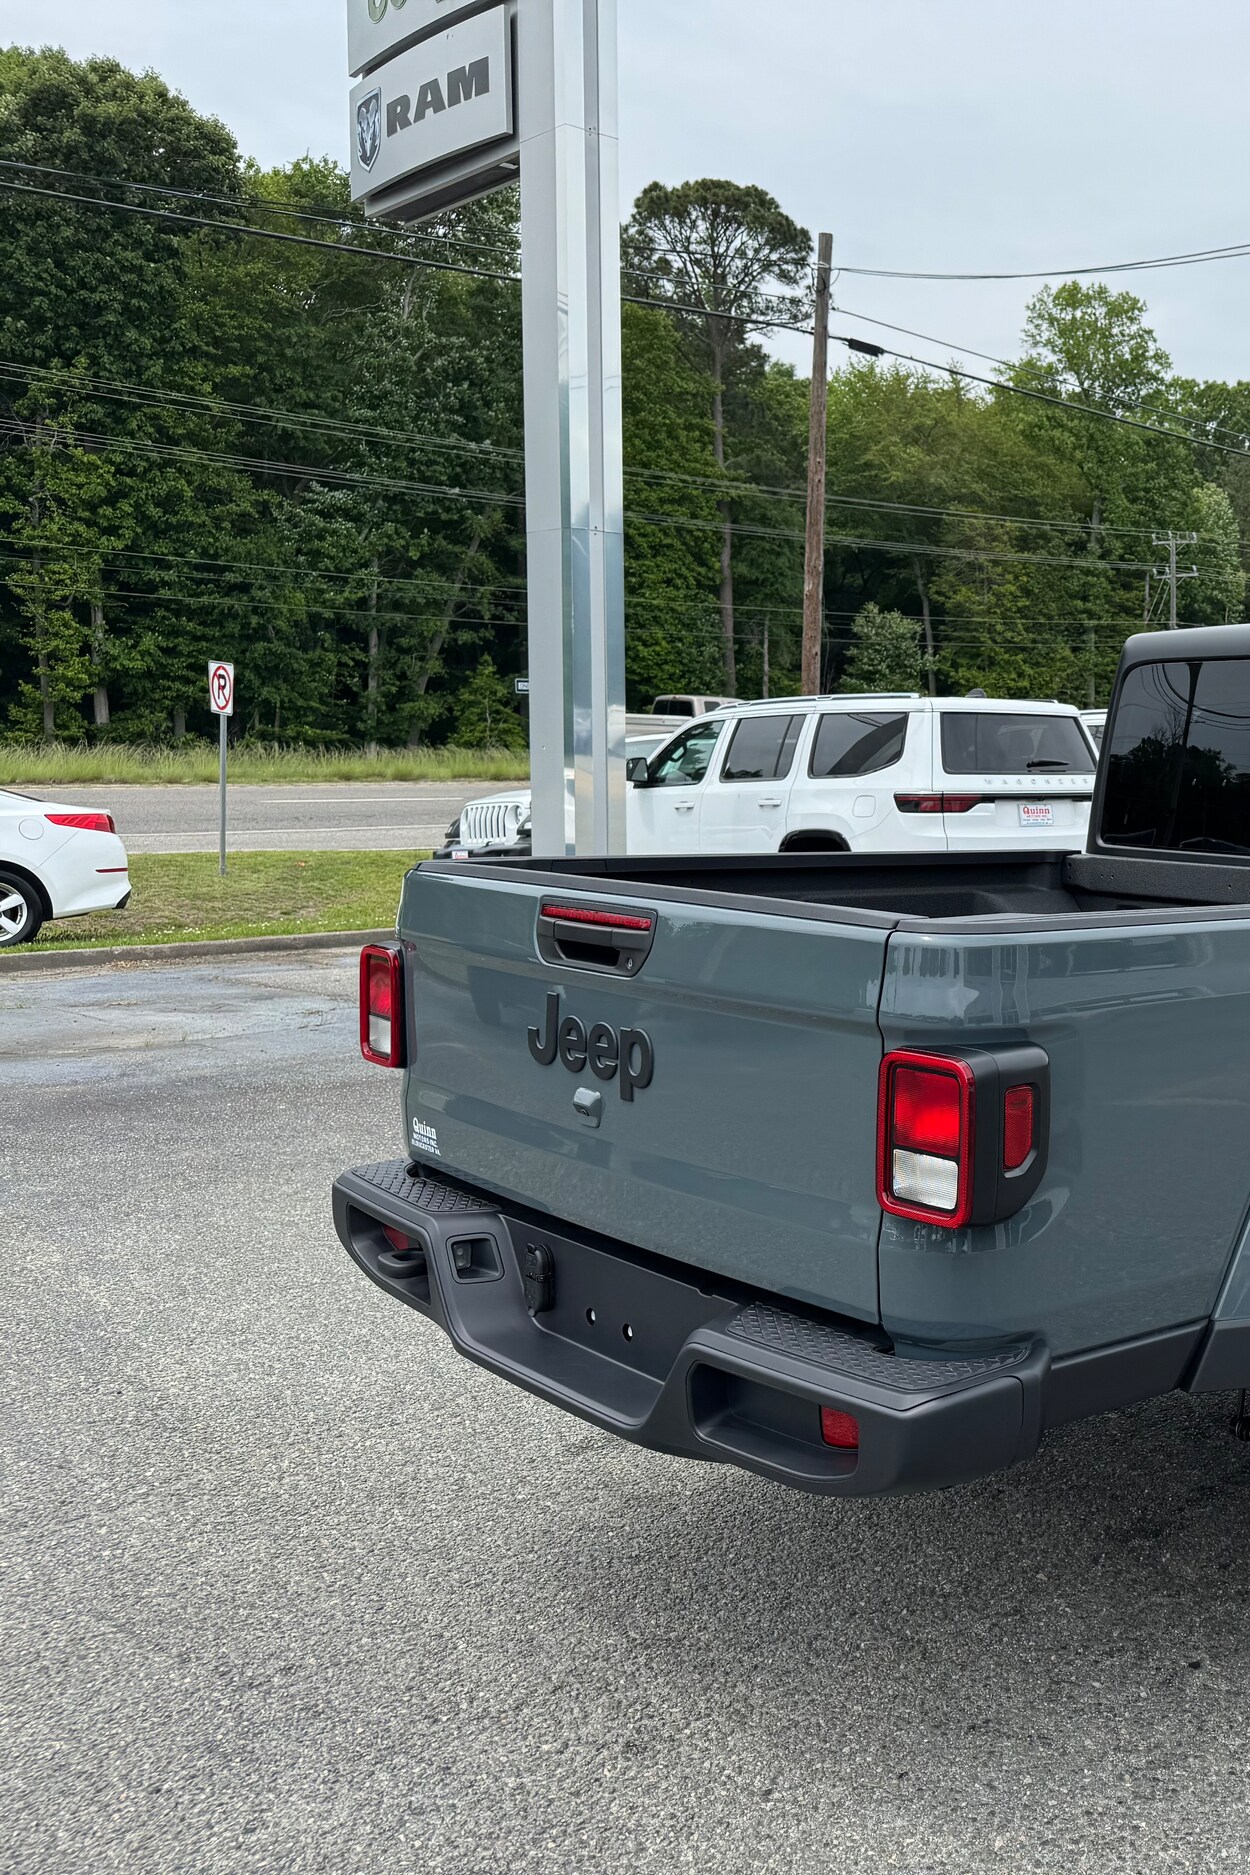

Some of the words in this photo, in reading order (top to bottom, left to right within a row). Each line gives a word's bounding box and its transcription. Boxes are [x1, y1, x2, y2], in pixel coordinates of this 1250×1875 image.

[386, 56, 490, 138] RAM
[1022, 805, 1051, 816] Quinn
[527, 991, 655, 1103] Jeep
[412, 1116, 437, 1140] Quinn
